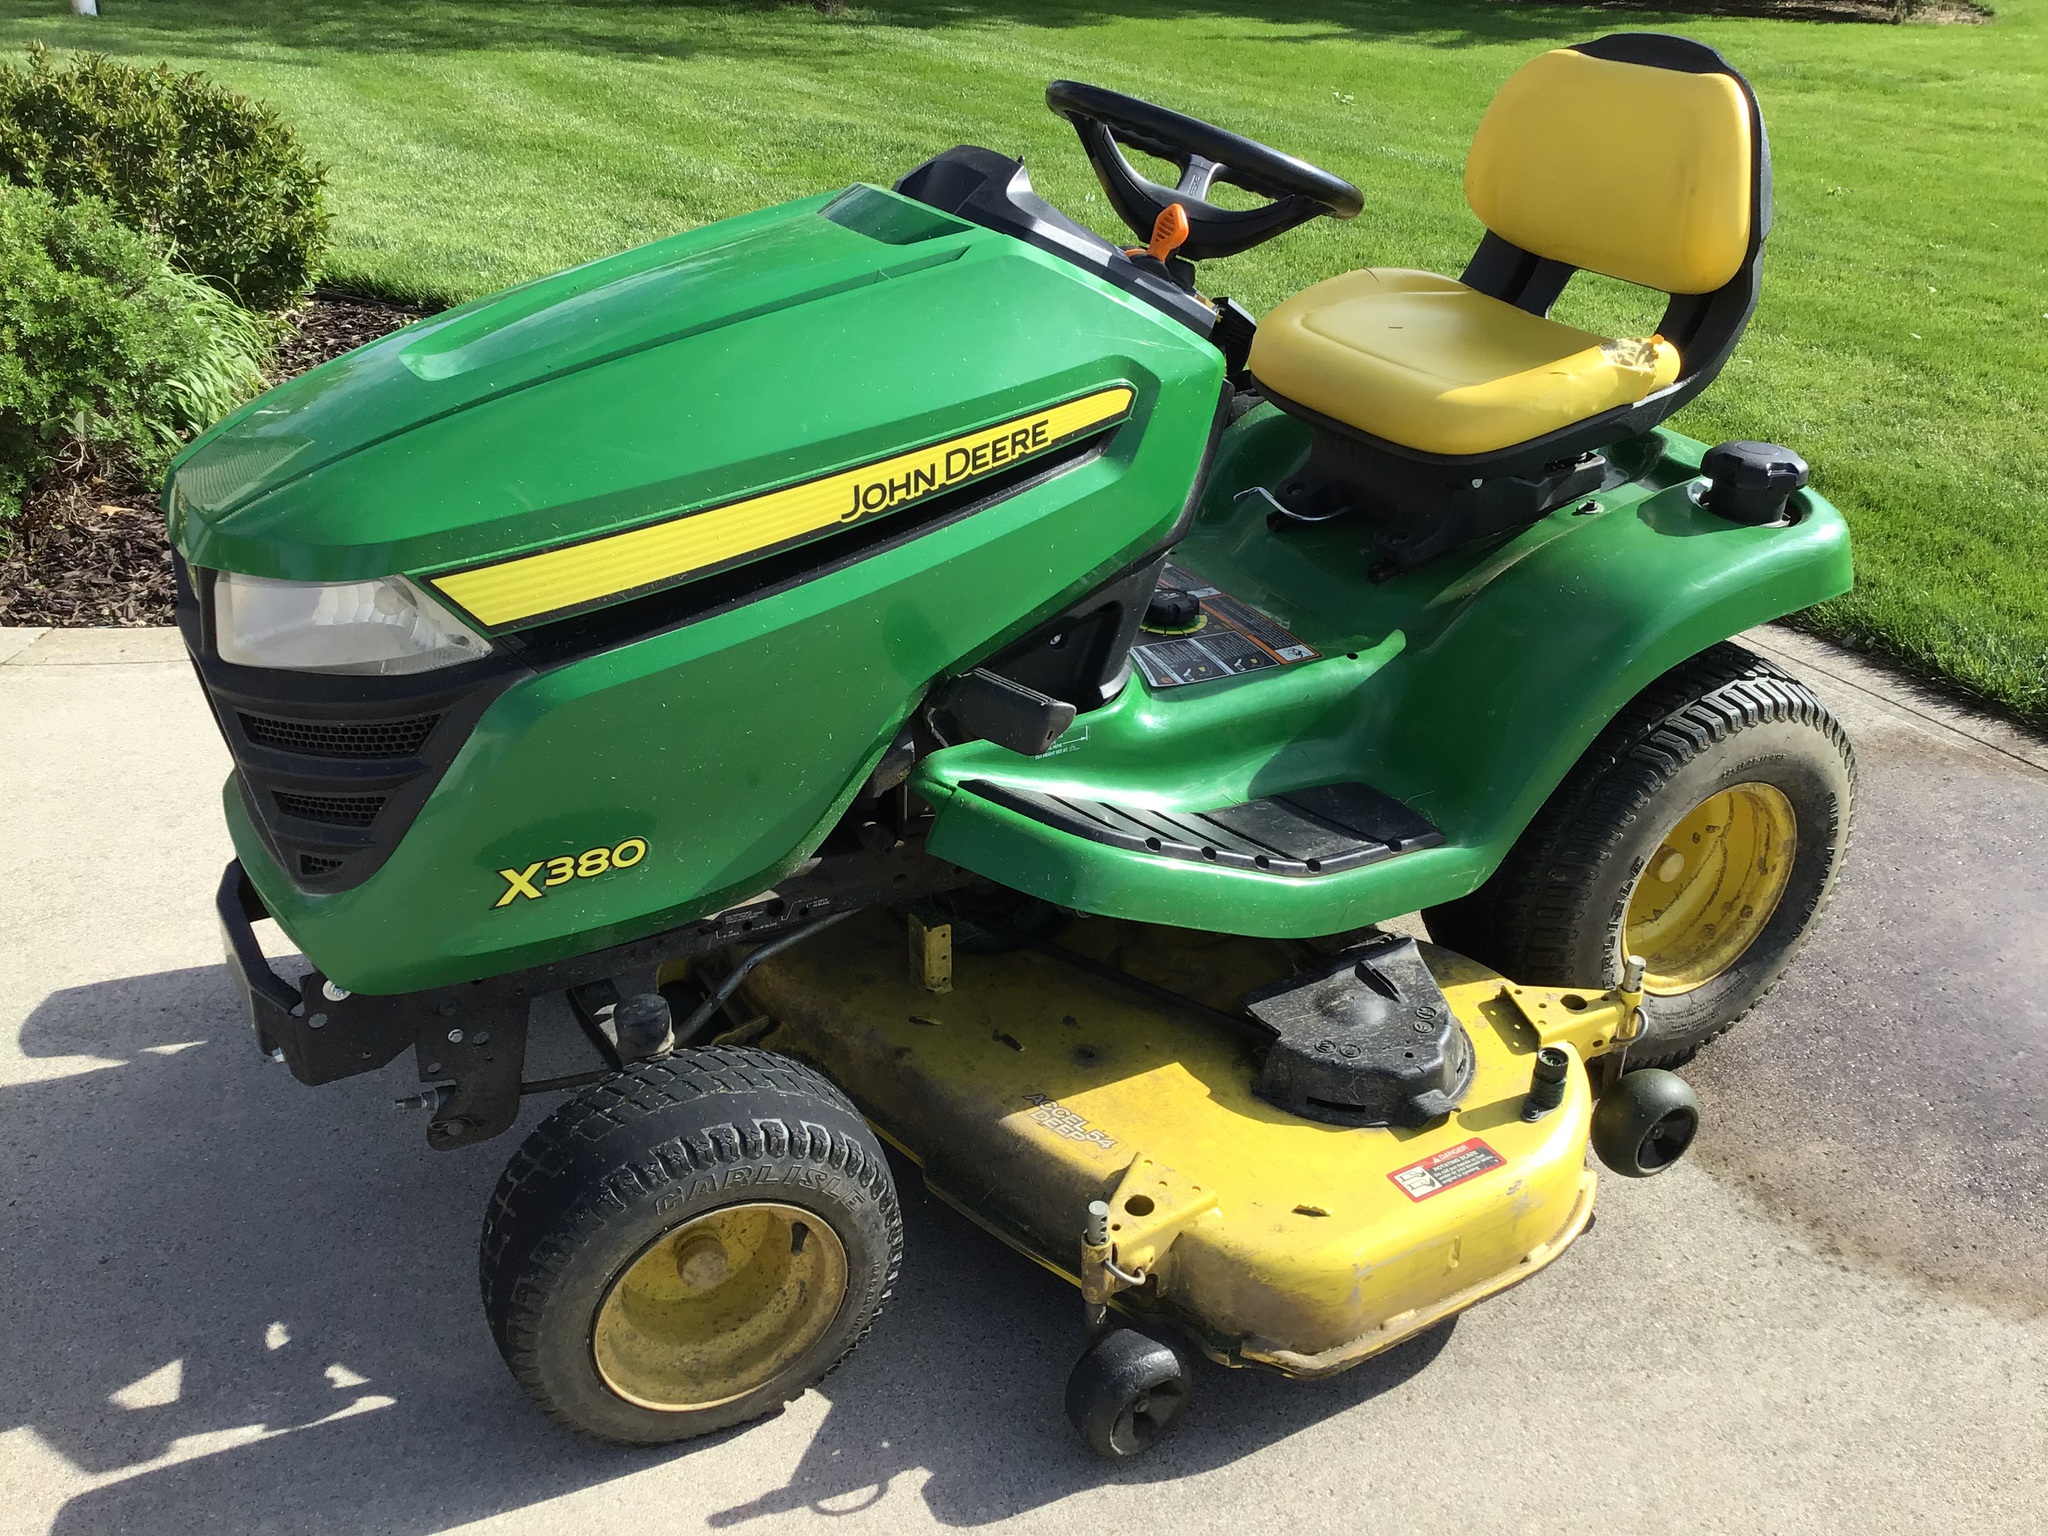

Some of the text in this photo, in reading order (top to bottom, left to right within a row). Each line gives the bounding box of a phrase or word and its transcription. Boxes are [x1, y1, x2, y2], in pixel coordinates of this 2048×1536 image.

[841, 419, 1050, 520] JOHN DEERE
[491, 837, 648, 909] X380
[1602, 855, 1645, 991] ARLISLE
[1022, 1093, 1118, 1149] ACCEL 54
[1029, 1109, 1086, 1141] DEEP
[1433, 1158, 1460, 1171] ROTATING
[1438, 1145, 1469, 1160] DANGER
[654, 1163, 866, 1216] CARLISLE
